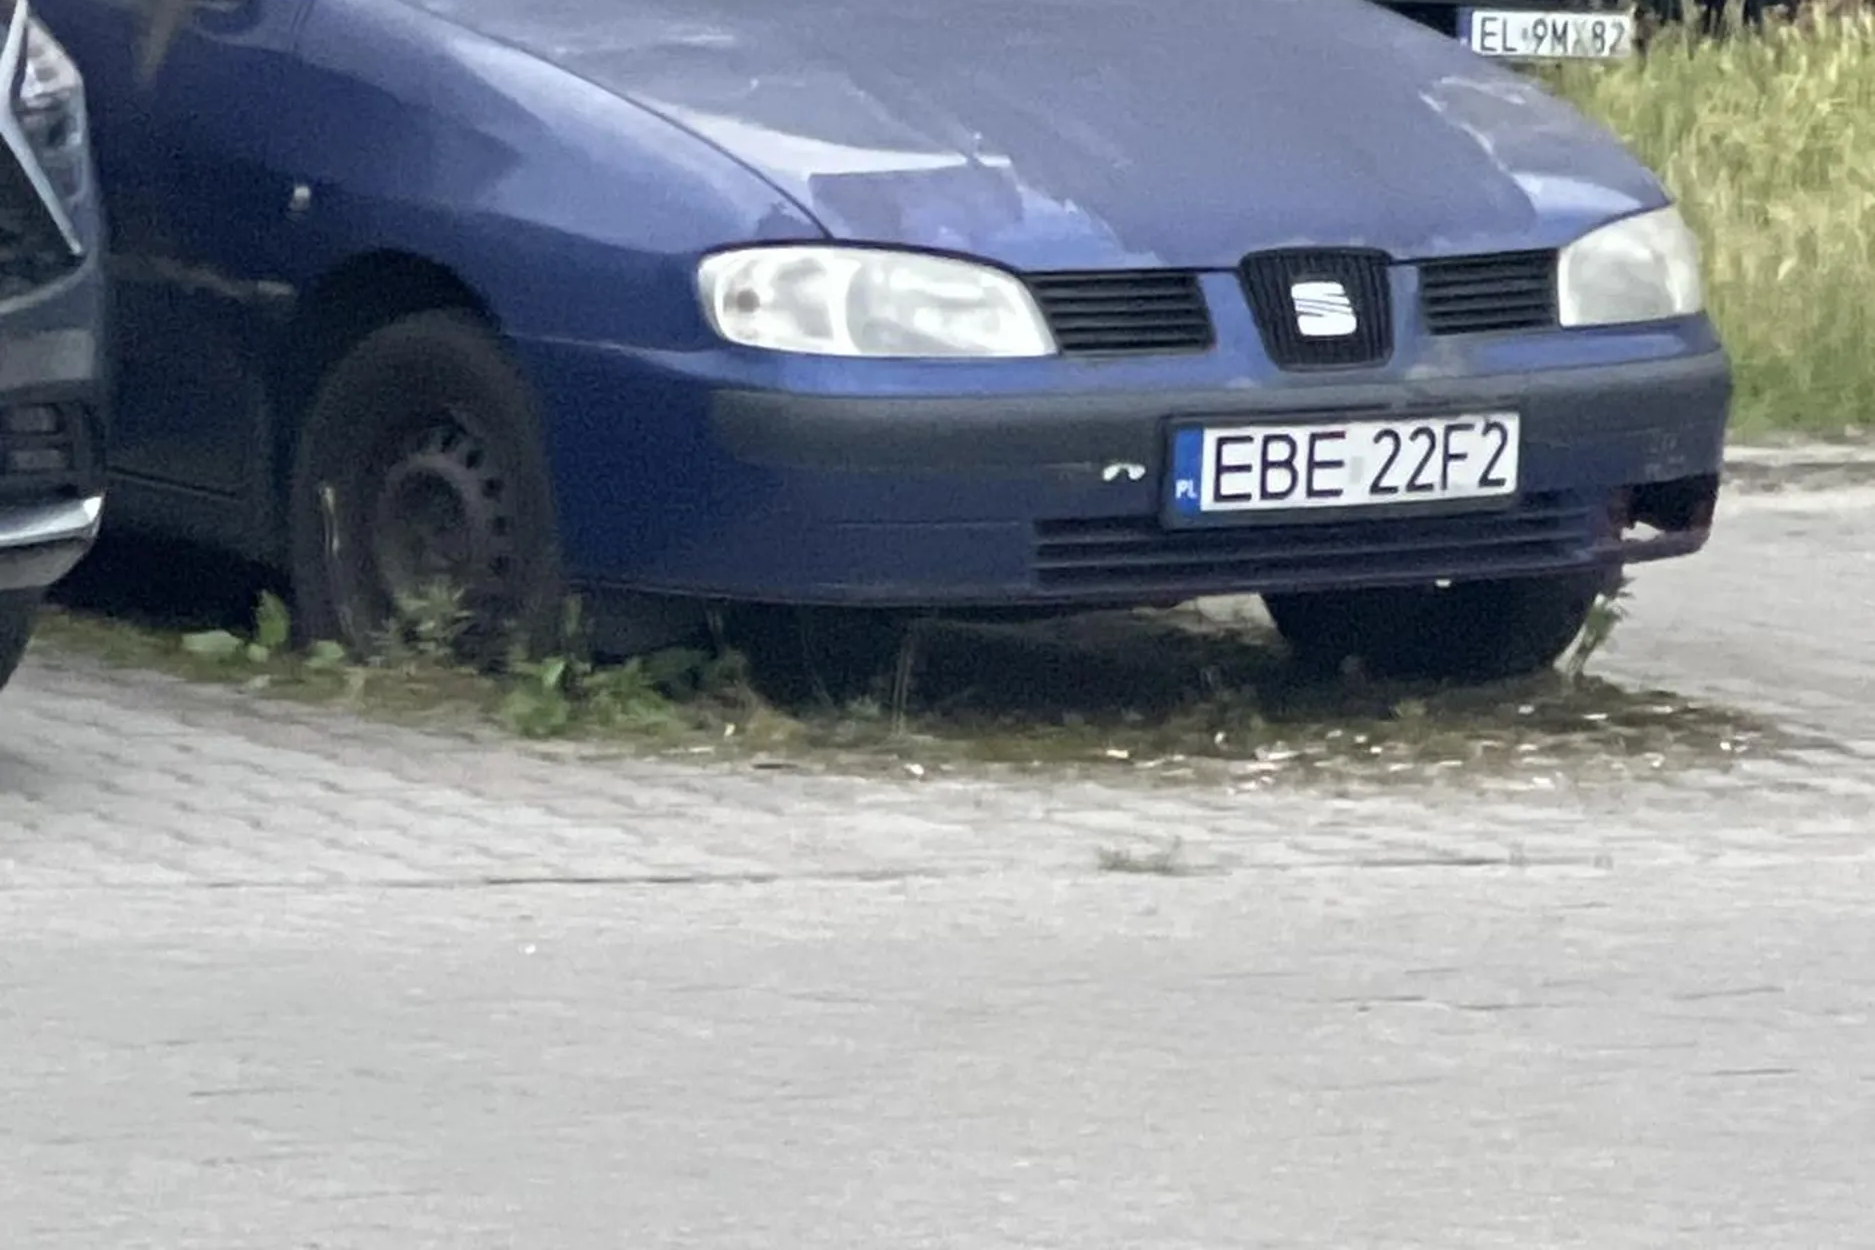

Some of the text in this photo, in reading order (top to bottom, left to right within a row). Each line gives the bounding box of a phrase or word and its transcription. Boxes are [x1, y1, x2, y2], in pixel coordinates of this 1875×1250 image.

[1480, 16, 1517, 52] EL
[1175, 421, 1508, 502] PL EBE 22F2
